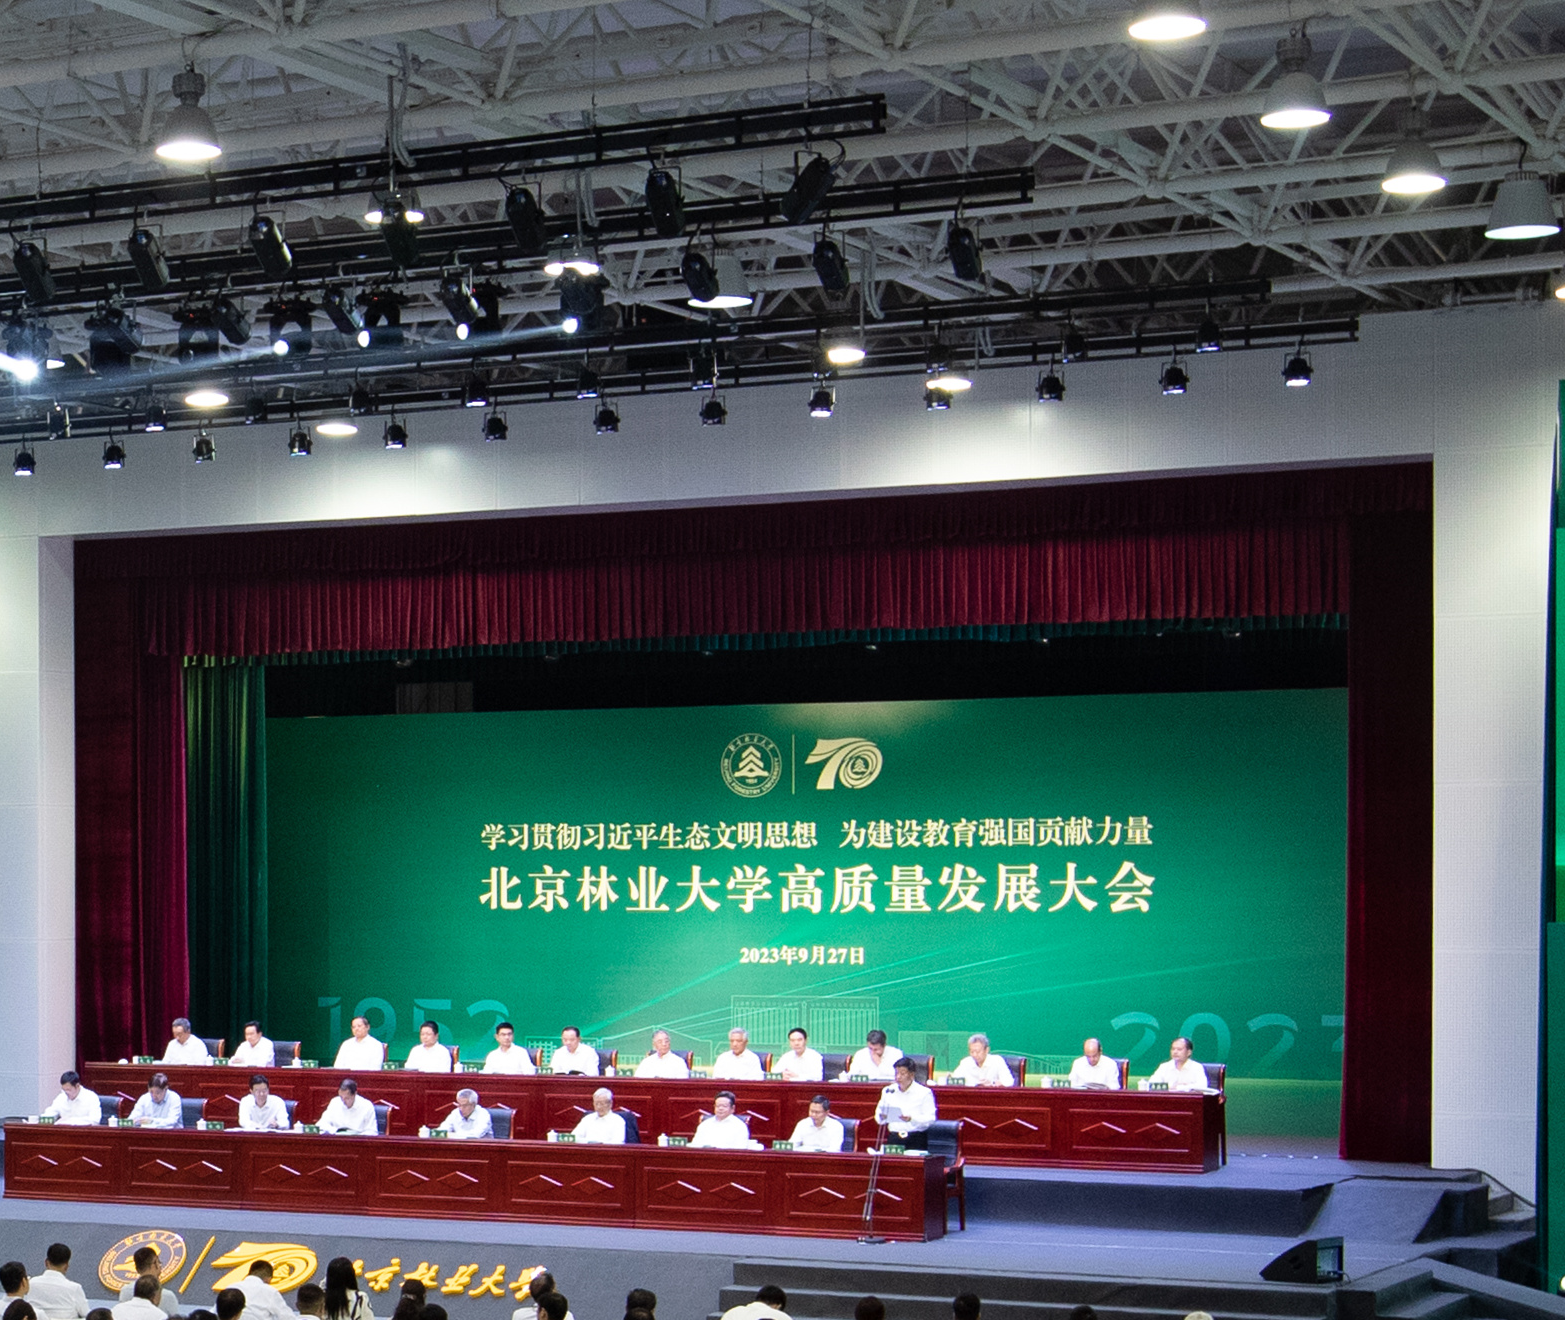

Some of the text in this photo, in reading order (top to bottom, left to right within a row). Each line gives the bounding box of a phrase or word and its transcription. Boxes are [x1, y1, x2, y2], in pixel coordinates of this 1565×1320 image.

[805, 737, 883, 790] 70
[481, 815, 1153, 850] 学习贯彻习近平生态文明思想 为建设教育强国贡献力量
[479, 861, 1155, 914] 北京林业大学高质量发展大会
[740, 945, 864, 965] 2023年9月27日
[318, 997, 509, 1060] 1952
[353, 1257, 548, 1300] 京林业大学
